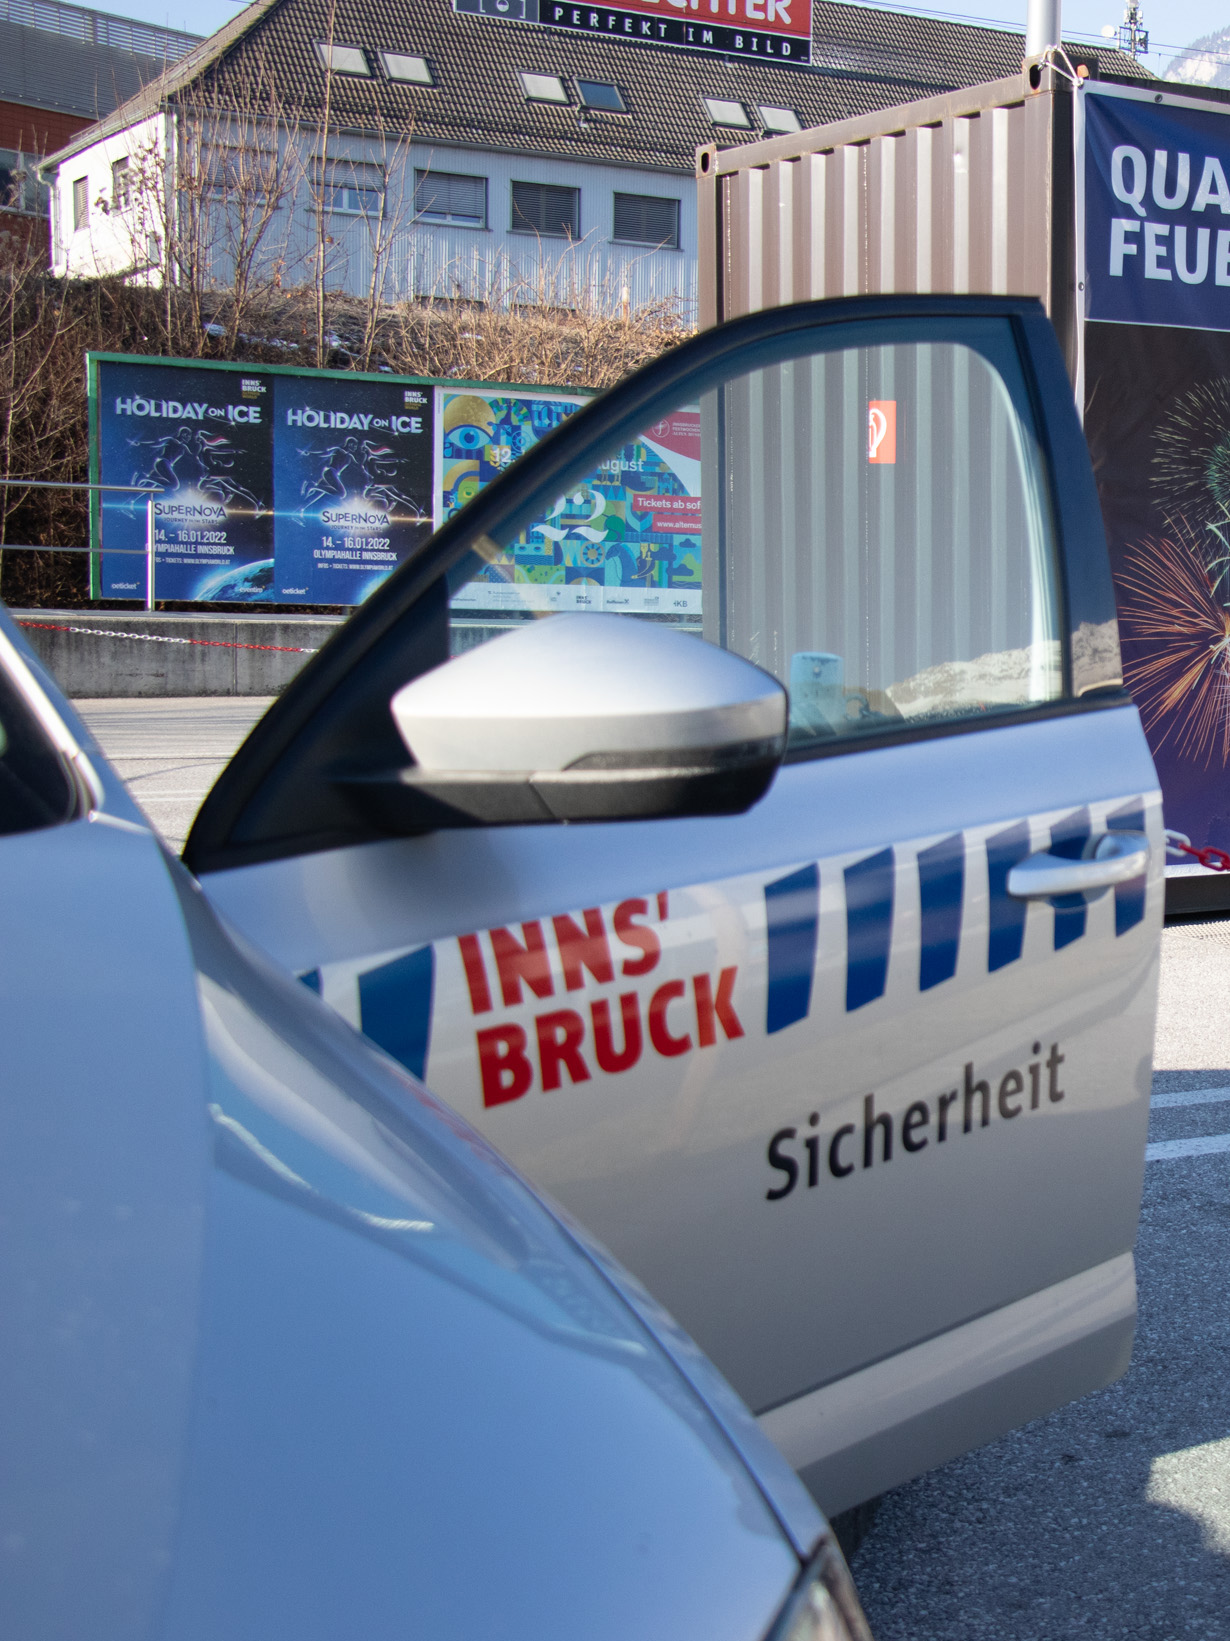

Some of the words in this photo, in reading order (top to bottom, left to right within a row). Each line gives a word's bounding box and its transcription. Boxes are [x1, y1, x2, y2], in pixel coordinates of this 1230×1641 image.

[554, 7, 667, 37] PERFEKT
[688, 28, 714, 44] IM
[735, 35, 791, 56] BILD
[115, 397, 208, 420] HOLIDAY
[208, 408, 225, 417] ON
[228, 405, 262, 424] ICE
[287, 408, 373, 430] HOLIDAY
[373, 418, 389, 427] ON
[391, 416, 424, 434] ICE
[599, 459, 644, 474] ugust
[637, 497, 671, 508] Tickets
[673, 500, 685, 509] ab
[154, 529, 168, 541] 14.
[178, 530, 227, 543] 16.01.2022
[322, 536, 335, 547] 14.
[344, 537, 390, 550] 16.01.2022
[197, 545, 235, 555] INNSBRUCK
[313, 549, 361, 560] OLYMPIAHALLE
[362, 551, 398, 561] INNSBRUCK
[457, 890, 669, 1015] INNS'
[476, 965, 746, 1109] BRUCK
[766, 1040, 1066, 1201] Sicherheit
